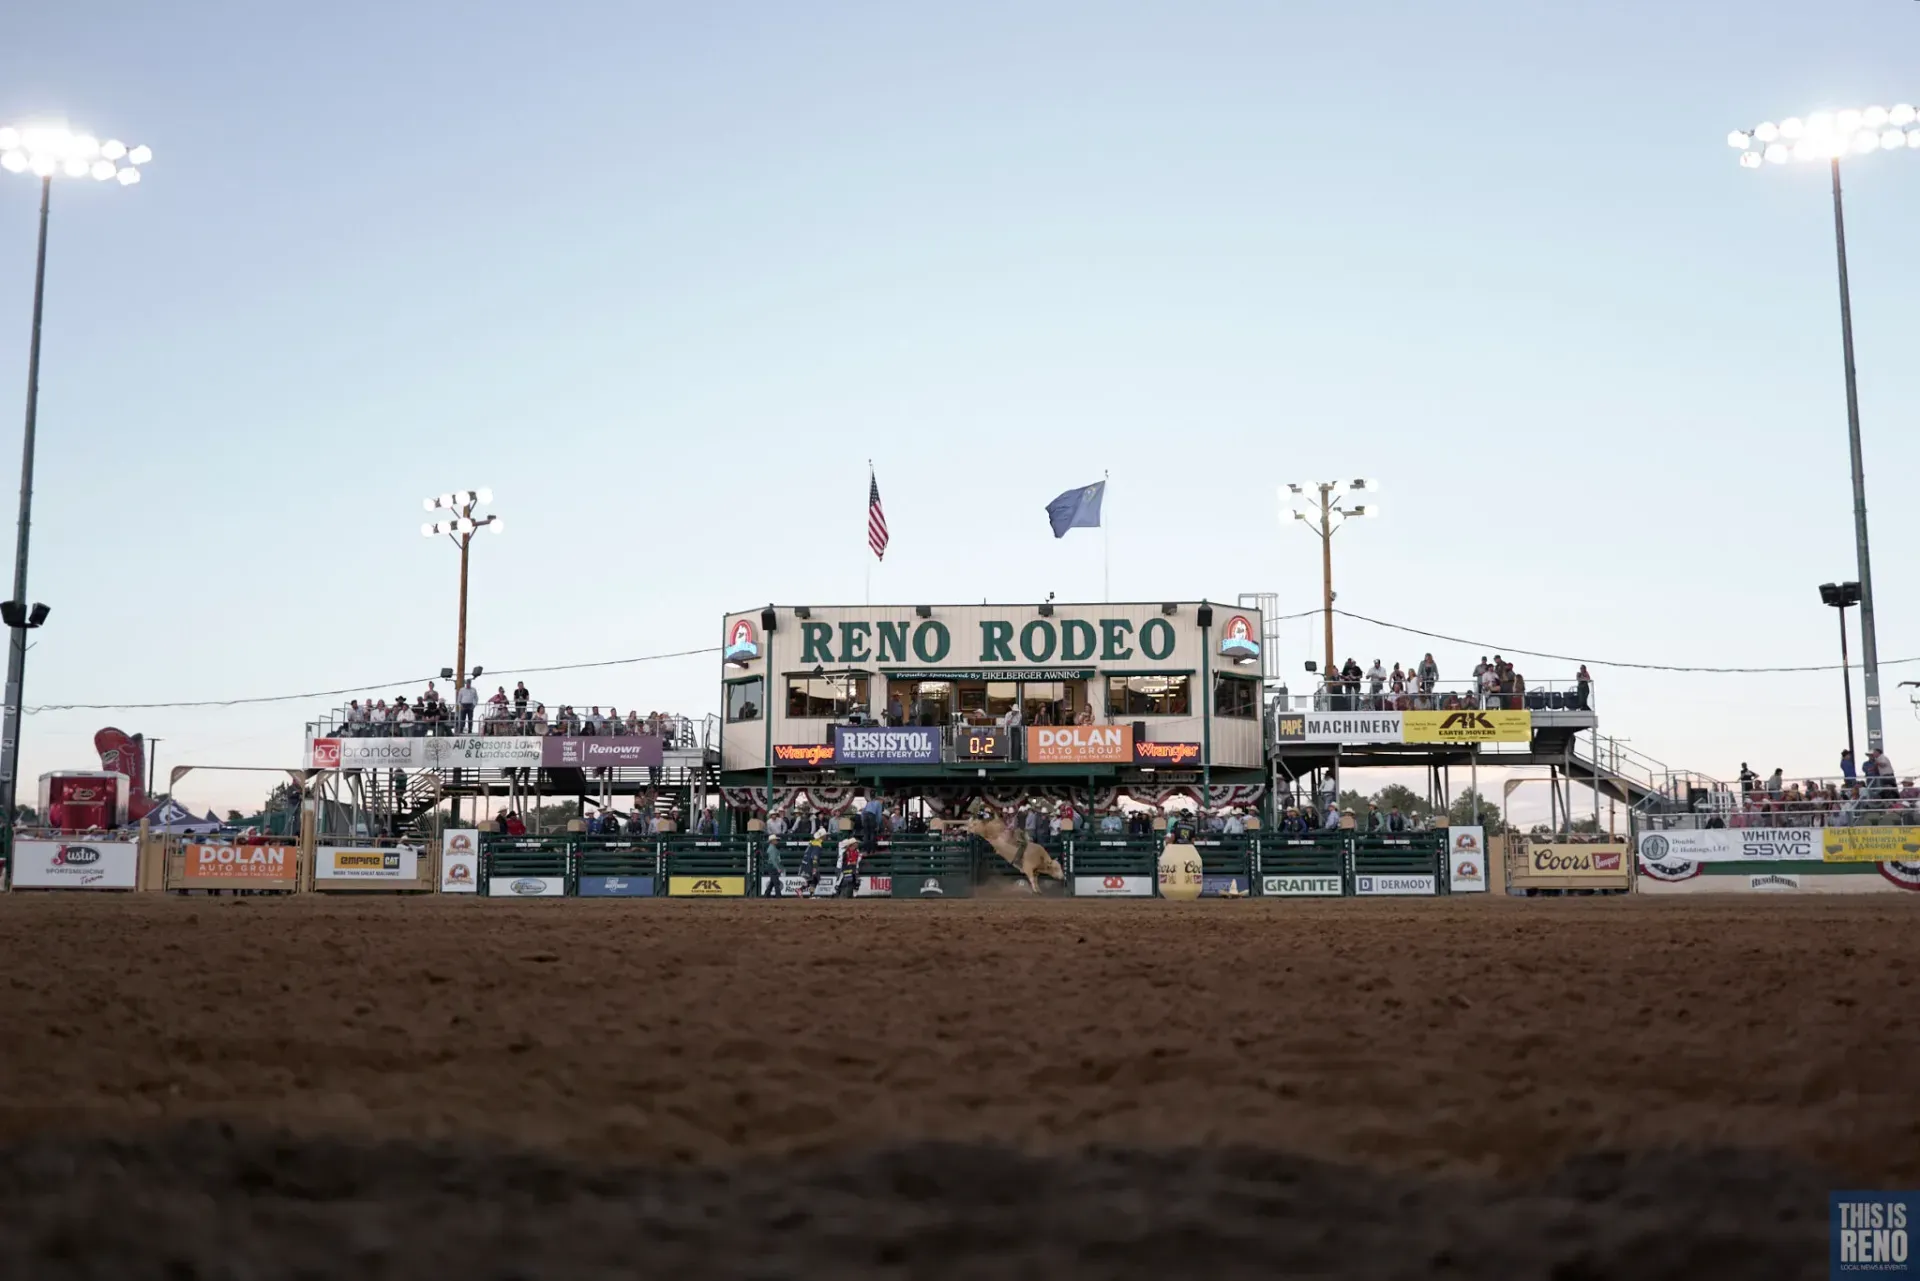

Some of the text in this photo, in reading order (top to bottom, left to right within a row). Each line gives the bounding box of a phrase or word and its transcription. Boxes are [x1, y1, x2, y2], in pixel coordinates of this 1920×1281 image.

[800, 618, 1176, 664] RENO RODEO
[982, 671, 1042, 680] EIKELBERGER
[1043, 671, 1080, 679] AWNING
[1308, 719, 1400, 734] MACHINERY
[842, 732, 931, 751] RESISTOL
[1039, 729, 1121, 747] DOLAN
[343, 742, 412, 758] branded
[453, 740, 542, 750] All Seasons Lawn
[589, 744, 642, 754] Renown
[1039, 747, 1122, 755] AUTO GROUP
[465, 749, 540, 760] & Landscaping
[775, 746, 834, 765] Wrangler
[1136, 743, 1198, 763] Wrangler
[1742, 830, 1811, 842] WHITMOR
[51, 845, 98, 866] Justin
[199, 847, 285, 864] DOLAN
[1743, 843, 1811, 856] SSWC
[384, 856, 399, 865] CAT
[1534, 848, 1590, 870] Coors
[240, 864, 284, 872] GROUP
[1264, 879, 1338, 892] GRANITE
[1381, 880, 1432, 889] DERMODY
